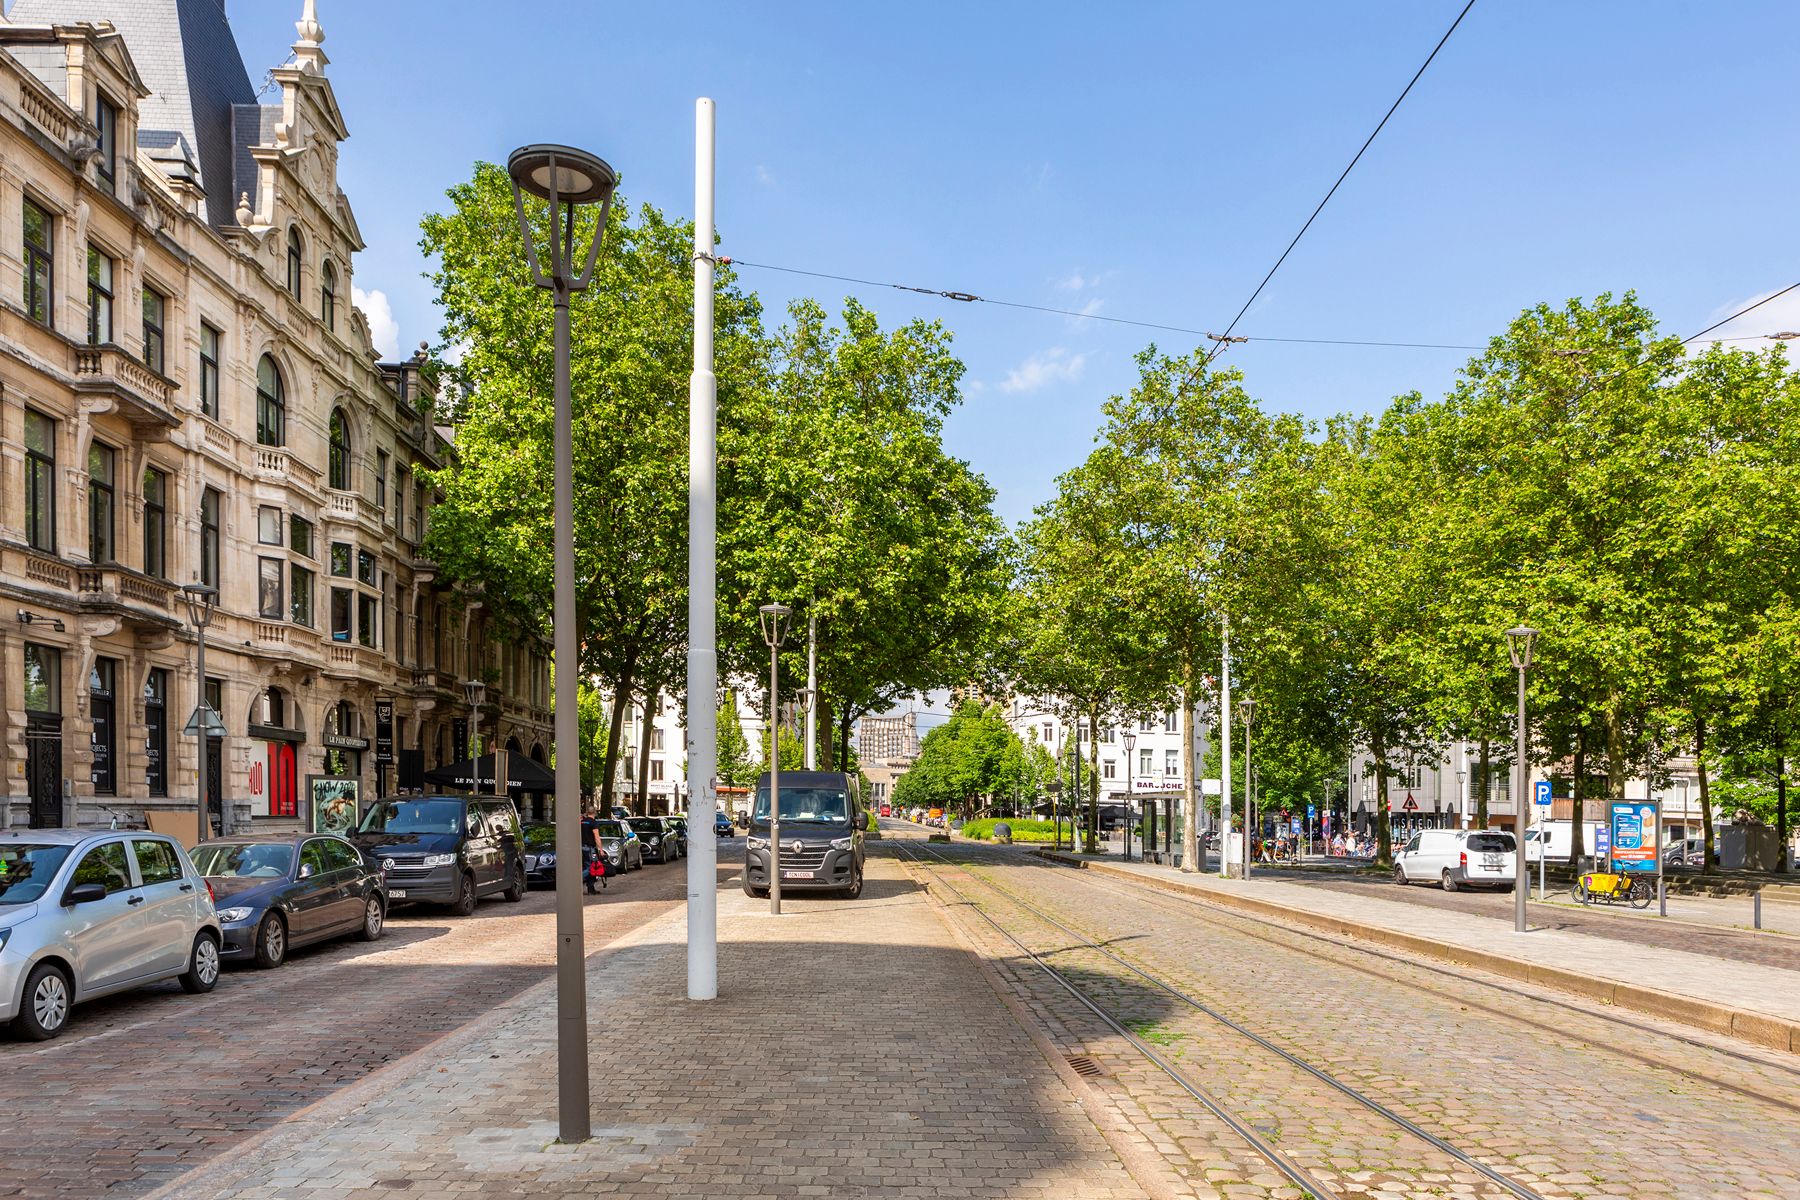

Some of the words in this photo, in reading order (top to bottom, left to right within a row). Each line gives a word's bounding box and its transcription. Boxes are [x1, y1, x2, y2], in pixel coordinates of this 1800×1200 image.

[483, 778, 522, 787] QUODIEN
[1538, 785, 1550, 802] P
[1308, 806, 1315, 814] P
